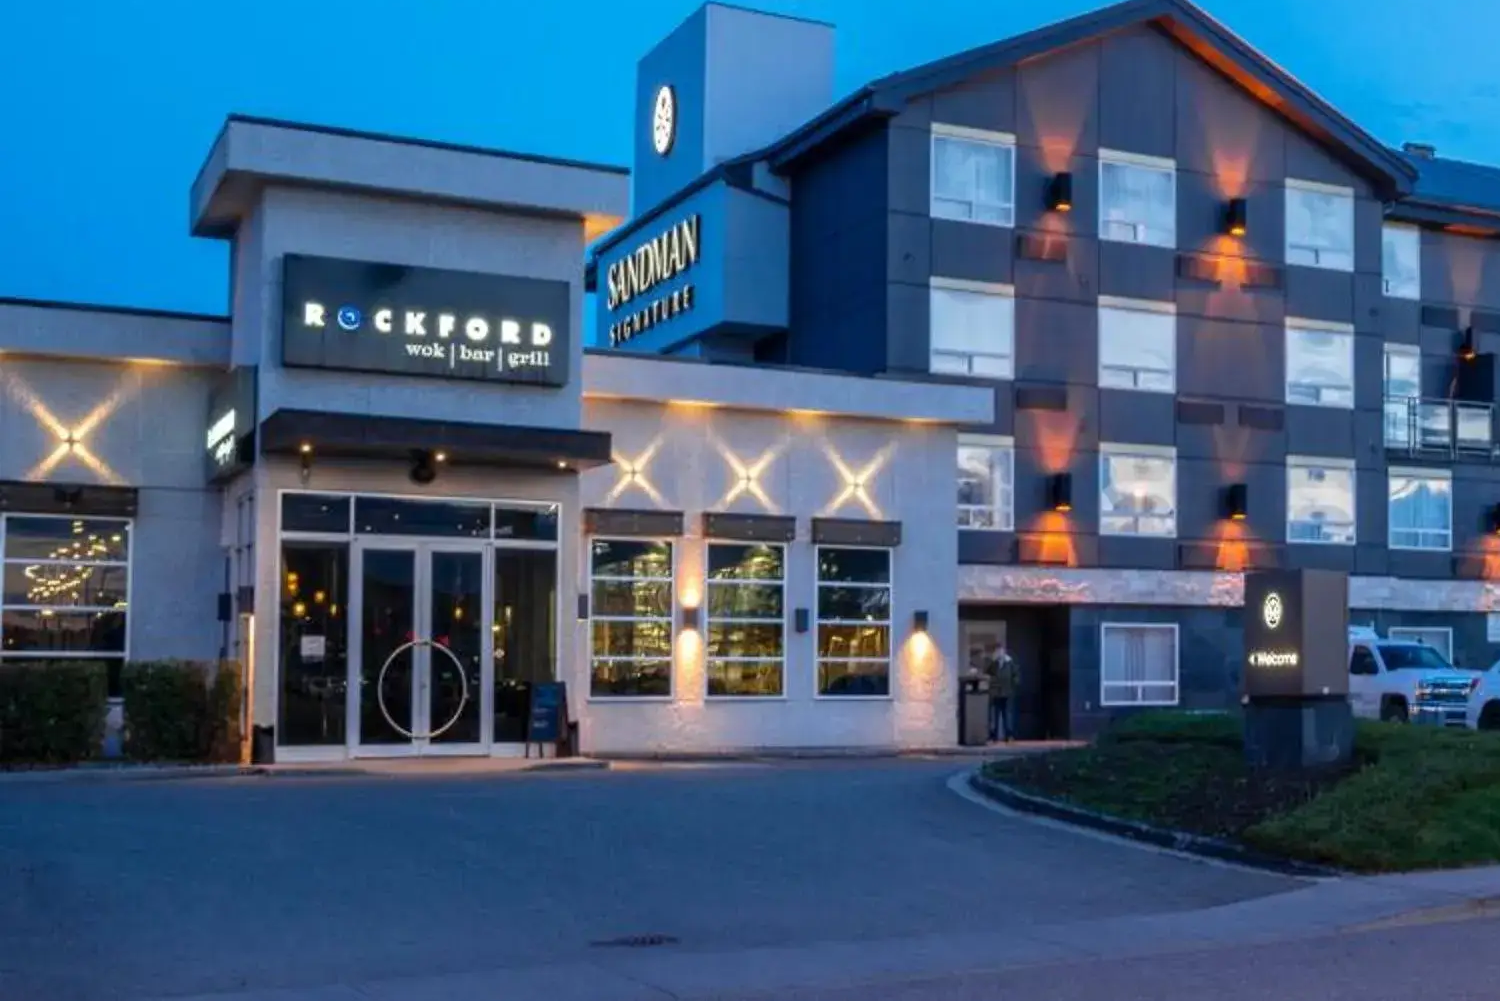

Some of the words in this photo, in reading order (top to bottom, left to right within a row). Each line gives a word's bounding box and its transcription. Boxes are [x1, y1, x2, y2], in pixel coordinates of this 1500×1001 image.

[607, 214, 700, 310] SANDMAN
[304, 302, 552, 346] ROCKFORD
[405, 343, 444, 358] wok
[460, 343, 495, 362] bar
[508, 349, 551, 368] grill
